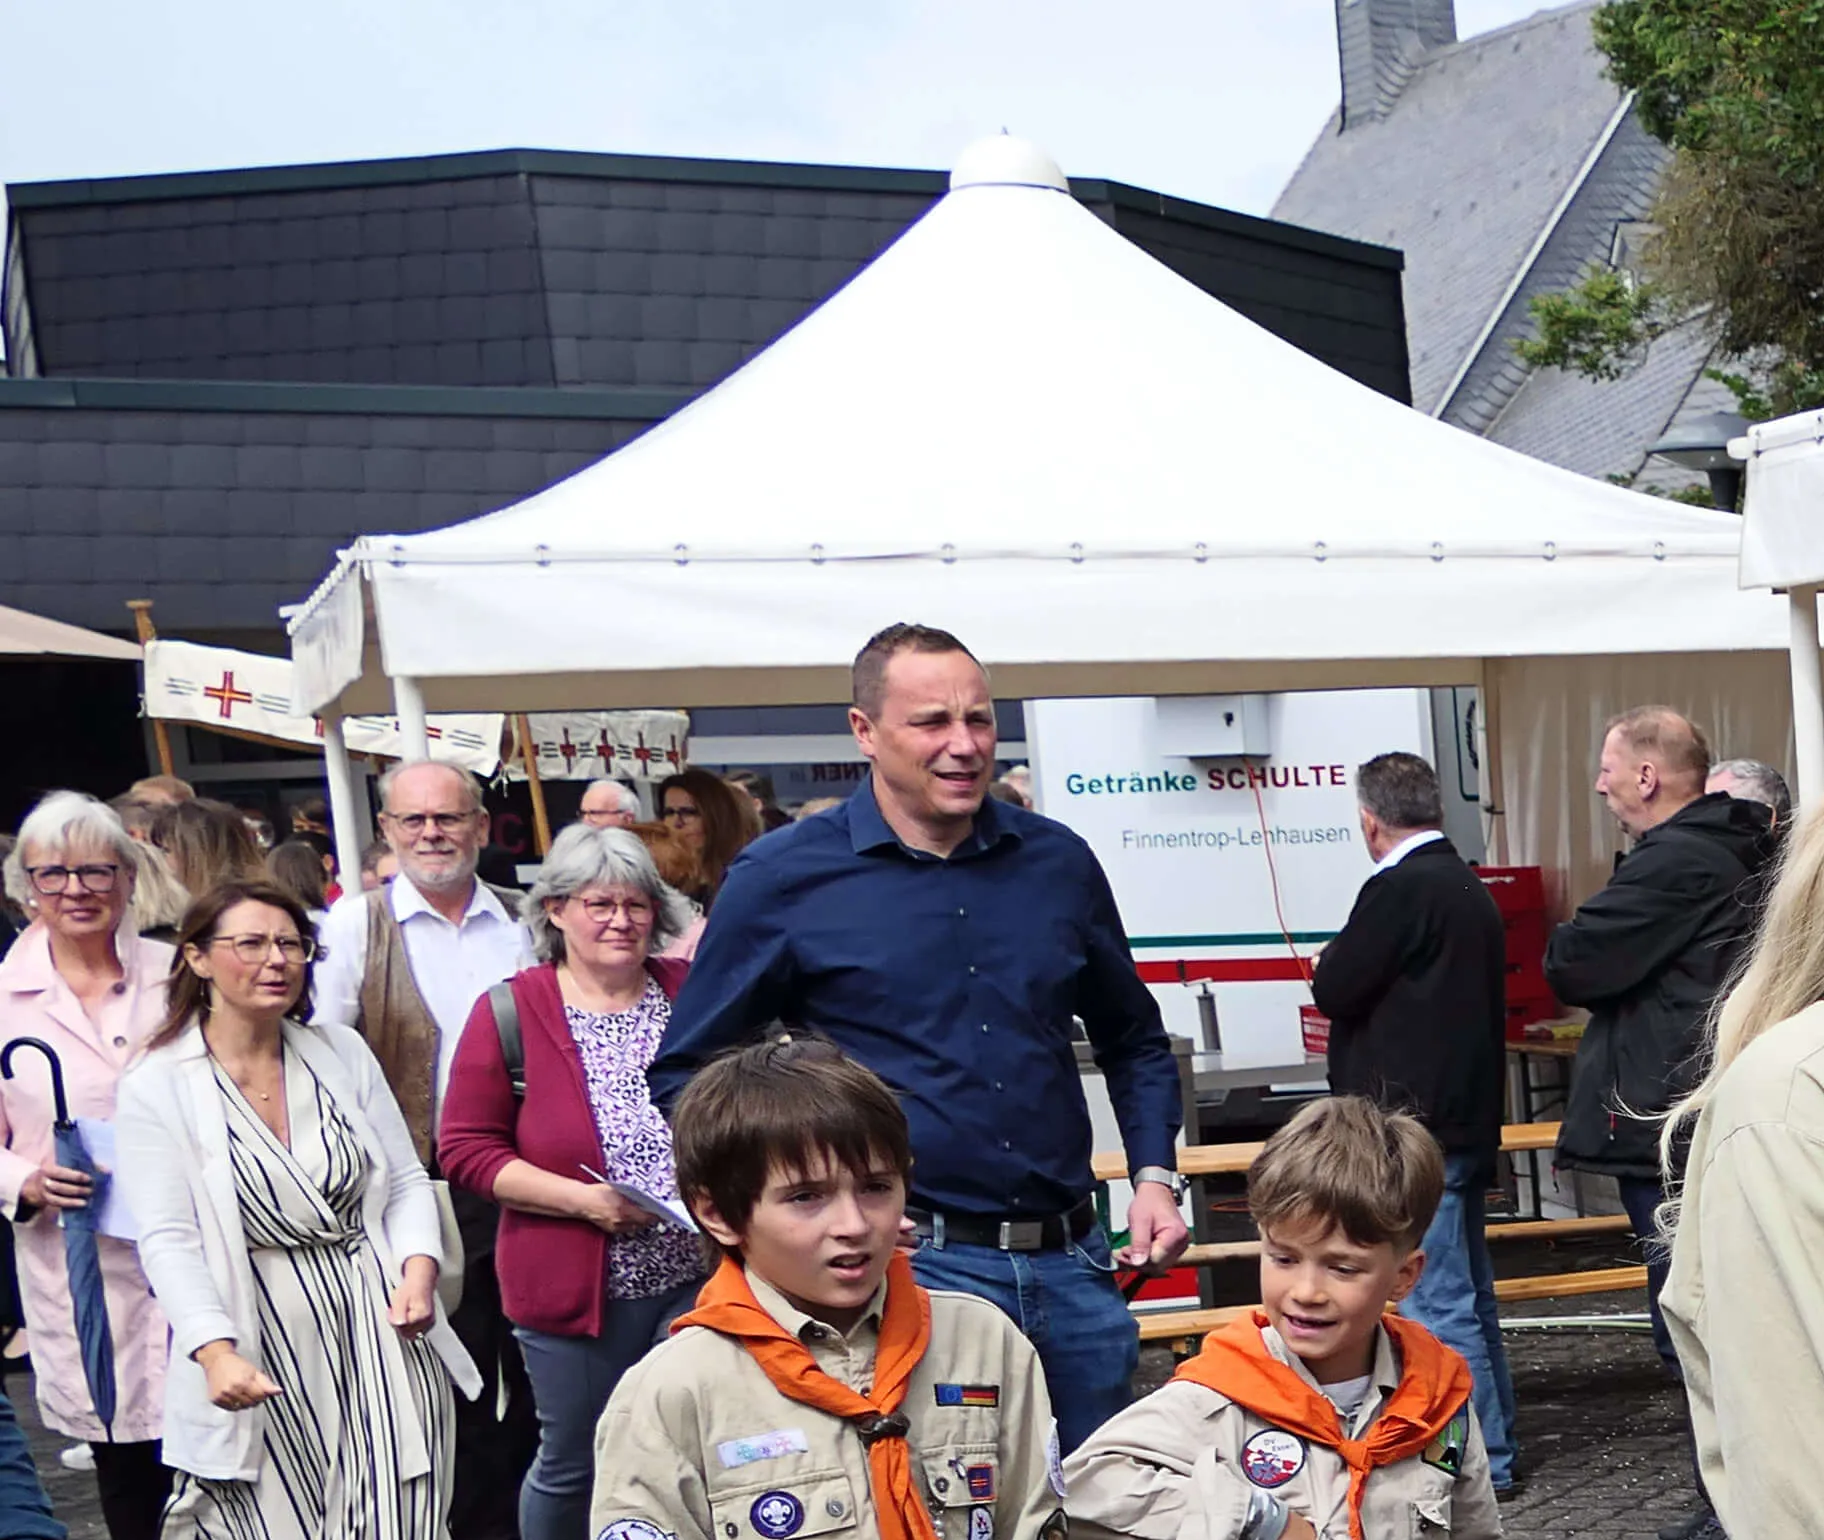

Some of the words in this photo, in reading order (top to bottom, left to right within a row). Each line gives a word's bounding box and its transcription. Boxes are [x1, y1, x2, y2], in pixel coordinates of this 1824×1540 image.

[1066, 770, 1198, 796] Getränke
[1208, 765, 1347, 790] SCHULTE
[1121, 826, 1350, 850] Finnentrop-Lenhausen
